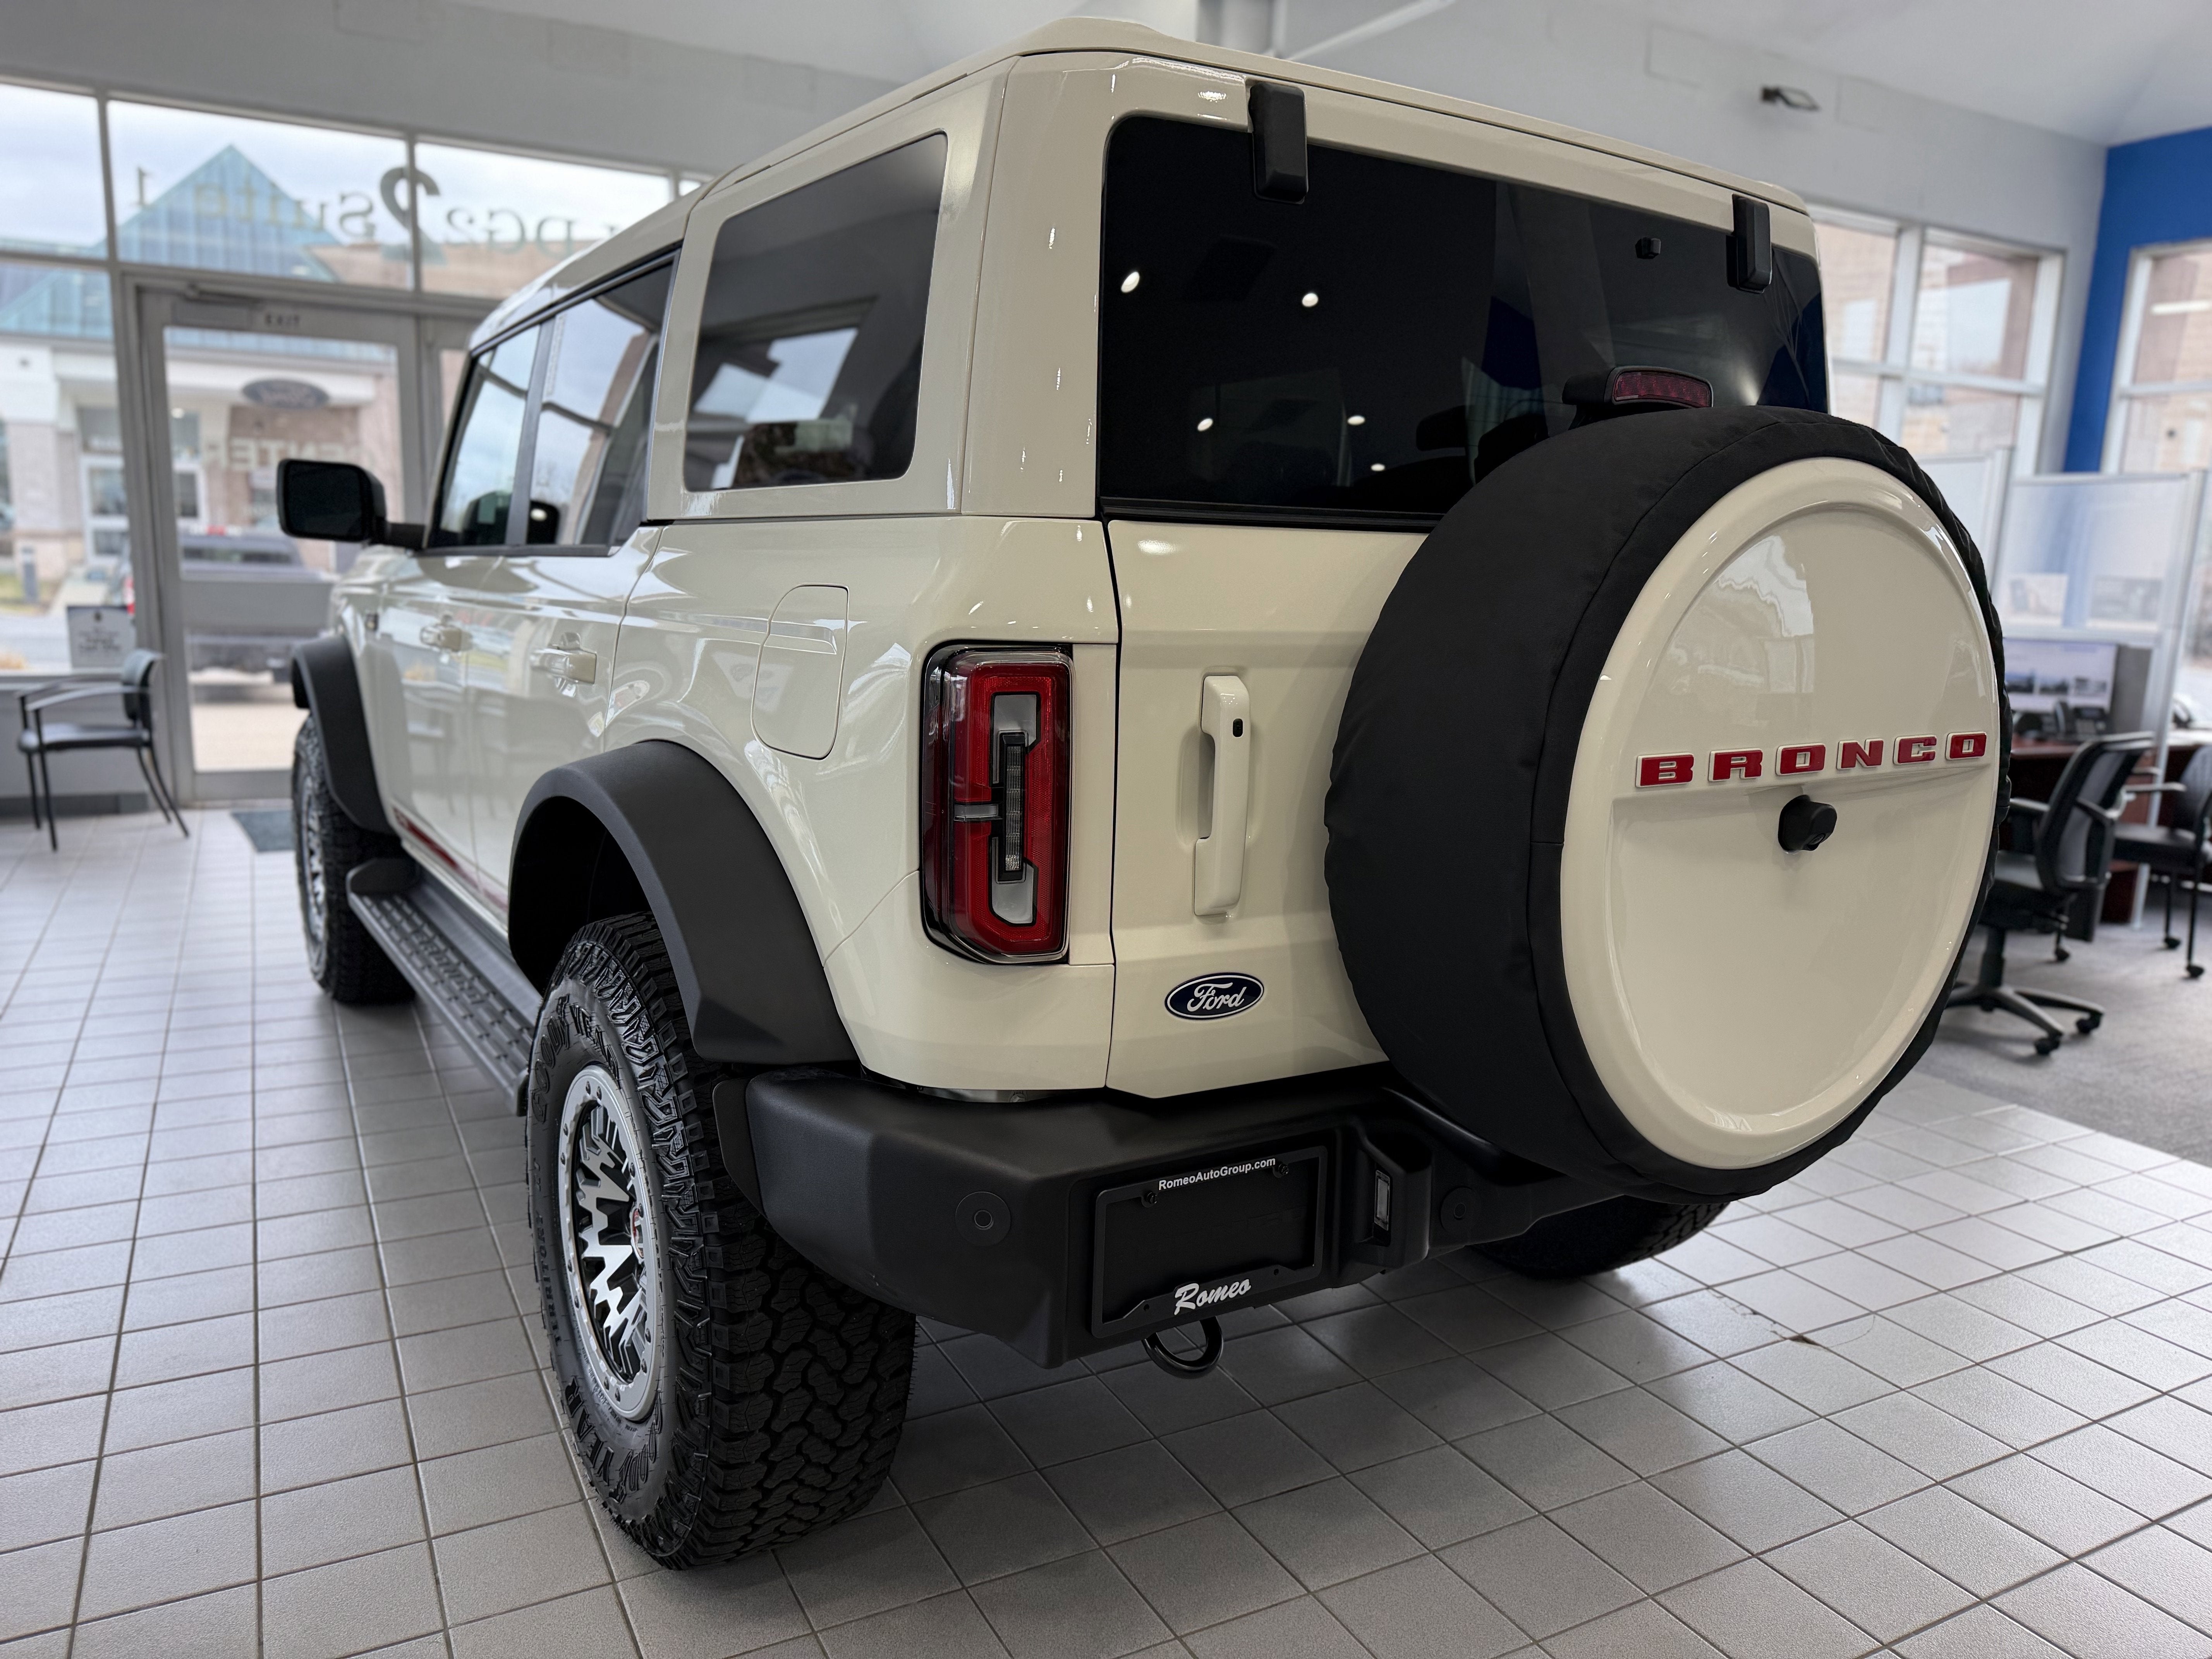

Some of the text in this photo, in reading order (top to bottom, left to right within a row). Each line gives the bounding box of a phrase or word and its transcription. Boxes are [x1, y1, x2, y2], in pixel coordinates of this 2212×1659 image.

[1636, 731, 1987, 788] BRONCO
[1187, 982, 1247, 1012] Ford
[1158, 1157, 1276, 1190] RomeoAutoGroup.com
[535, 1211, 562, 1346] TERRITORY
[1174, 1278, 1252, 1315] Romeo
